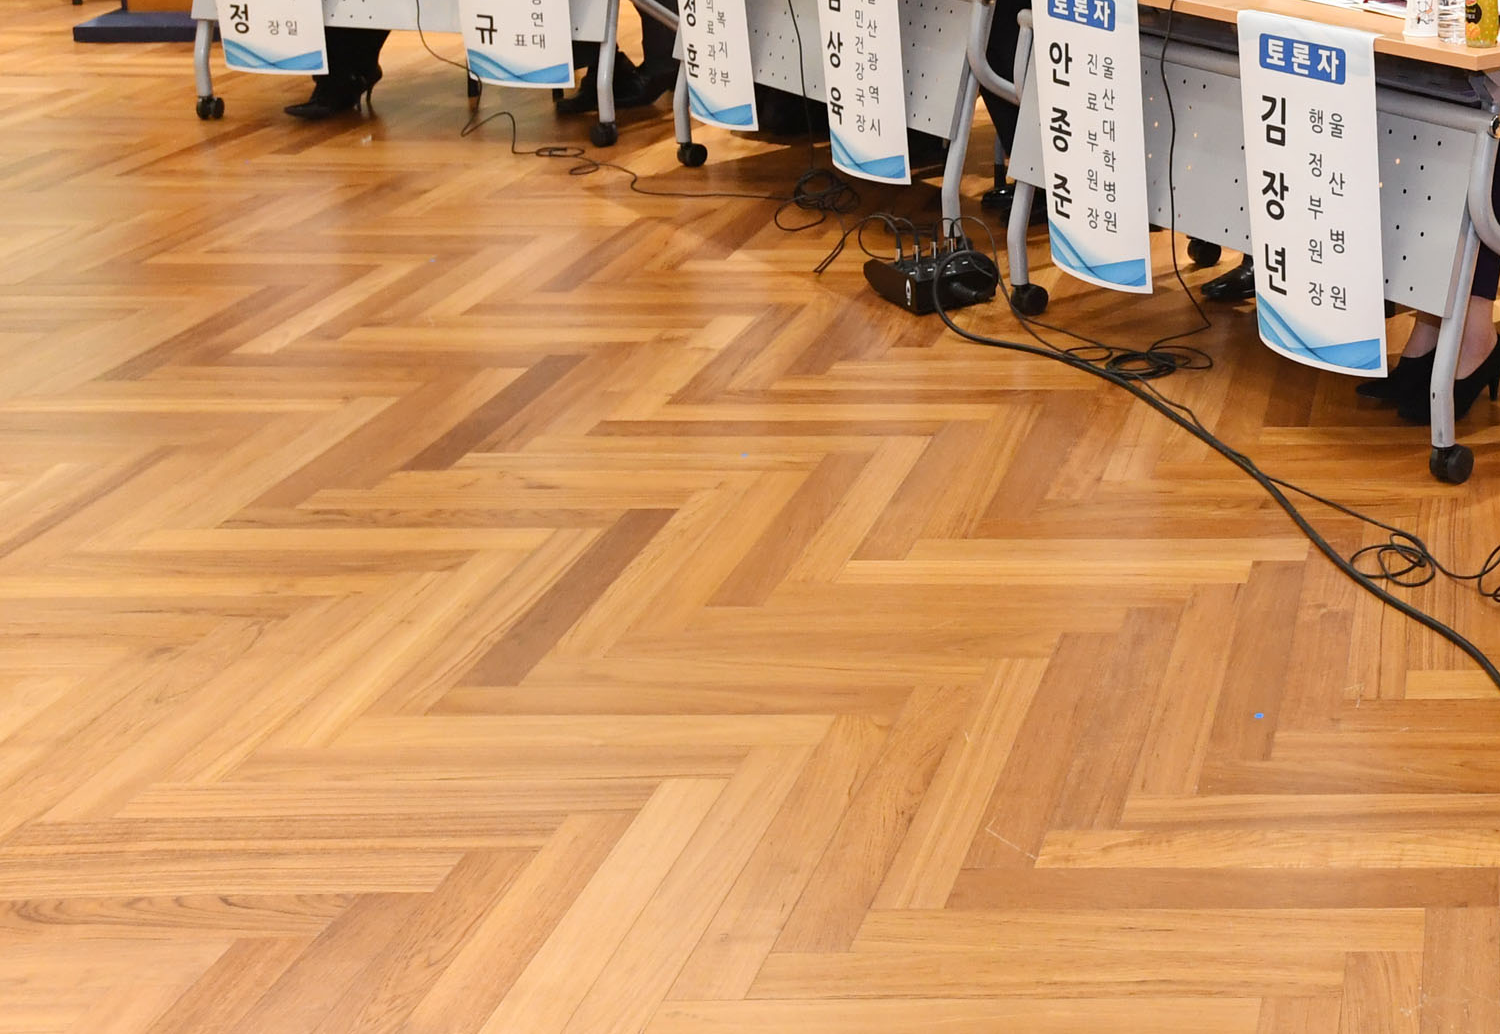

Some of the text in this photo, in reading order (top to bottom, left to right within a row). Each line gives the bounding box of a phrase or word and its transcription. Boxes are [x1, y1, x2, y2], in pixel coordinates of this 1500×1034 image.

[1048, 41, 1073, 220] 안종준
[1101, 55, 1118, 234] 울산대학병원
[1265, 36, 1341, 82] 토론자
[1260, 94, 1290, 296] 김장년
[1308, 108, 1325, 308] 행정부원장
[1328, 112, 1347, 311] 울산병원
